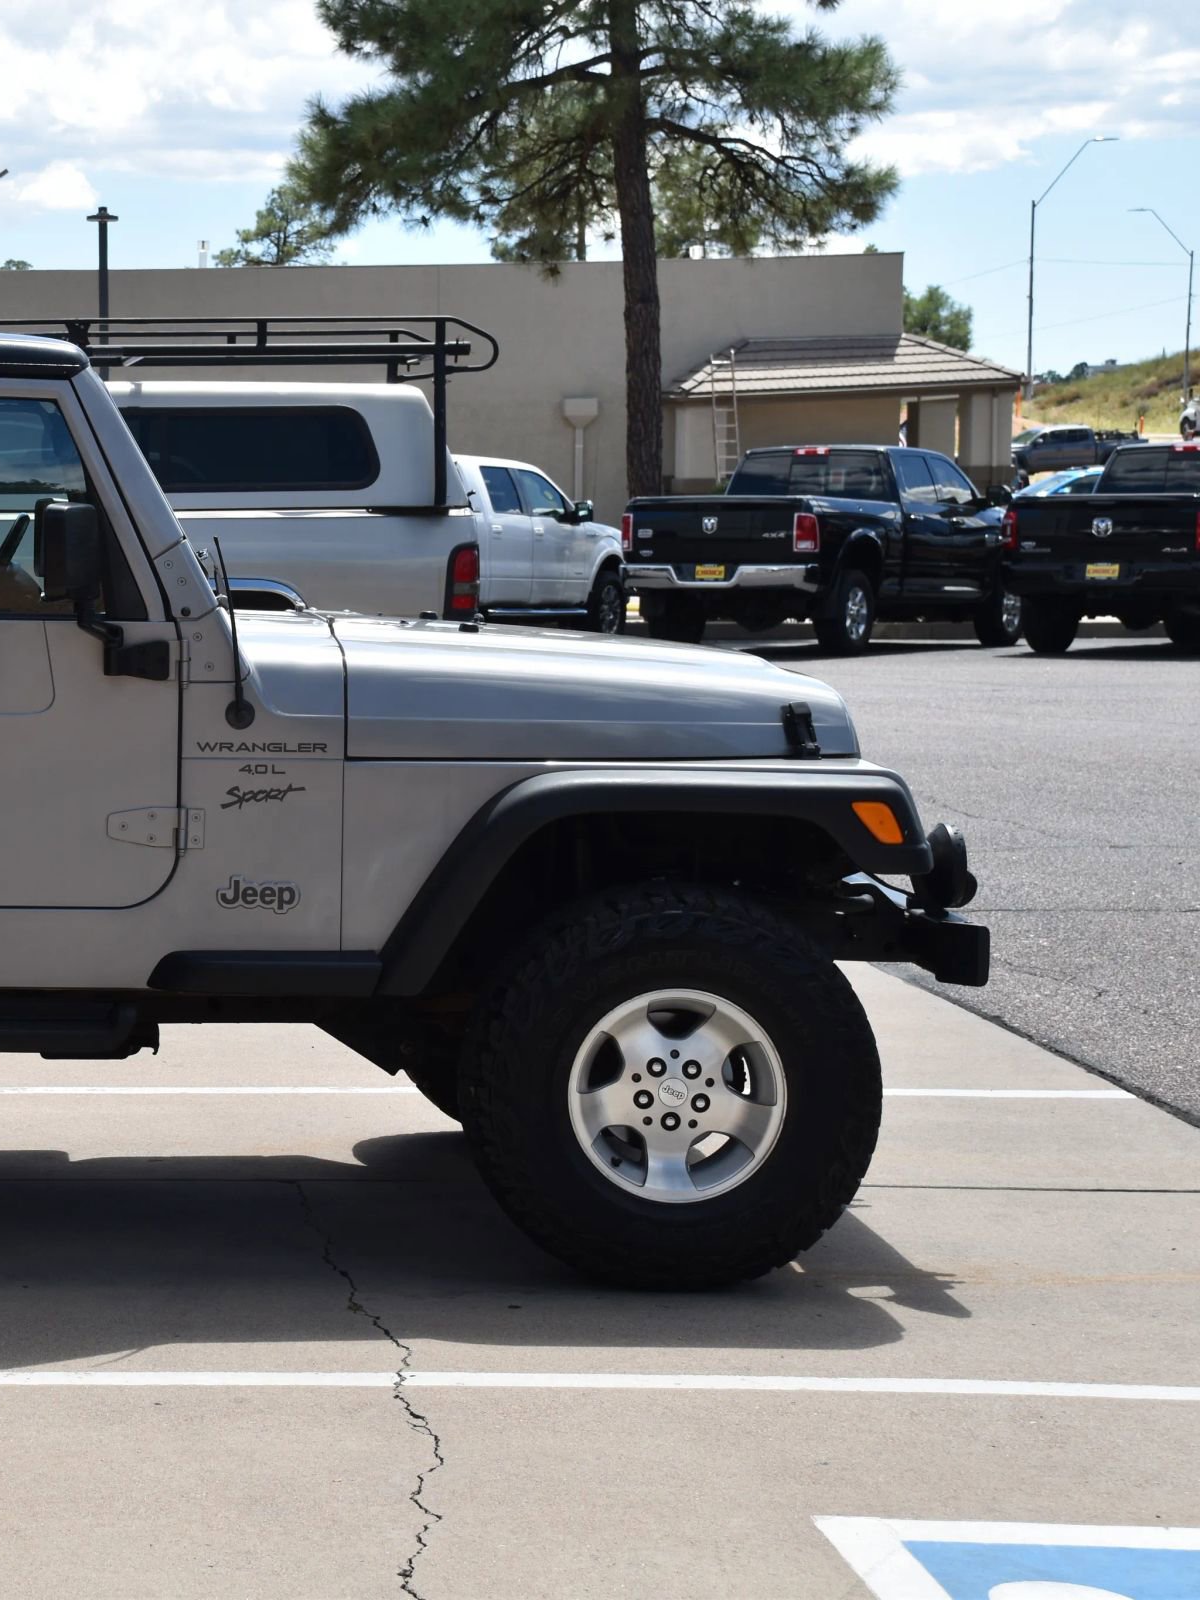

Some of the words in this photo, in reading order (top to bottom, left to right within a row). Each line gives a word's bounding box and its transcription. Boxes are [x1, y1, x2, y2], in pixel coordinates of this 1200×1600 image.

[196, 741, 328, 753] WRANGLER
[219, 879, 296, 911] Jeep
[662, 1085, 686, 1100] Jeep
